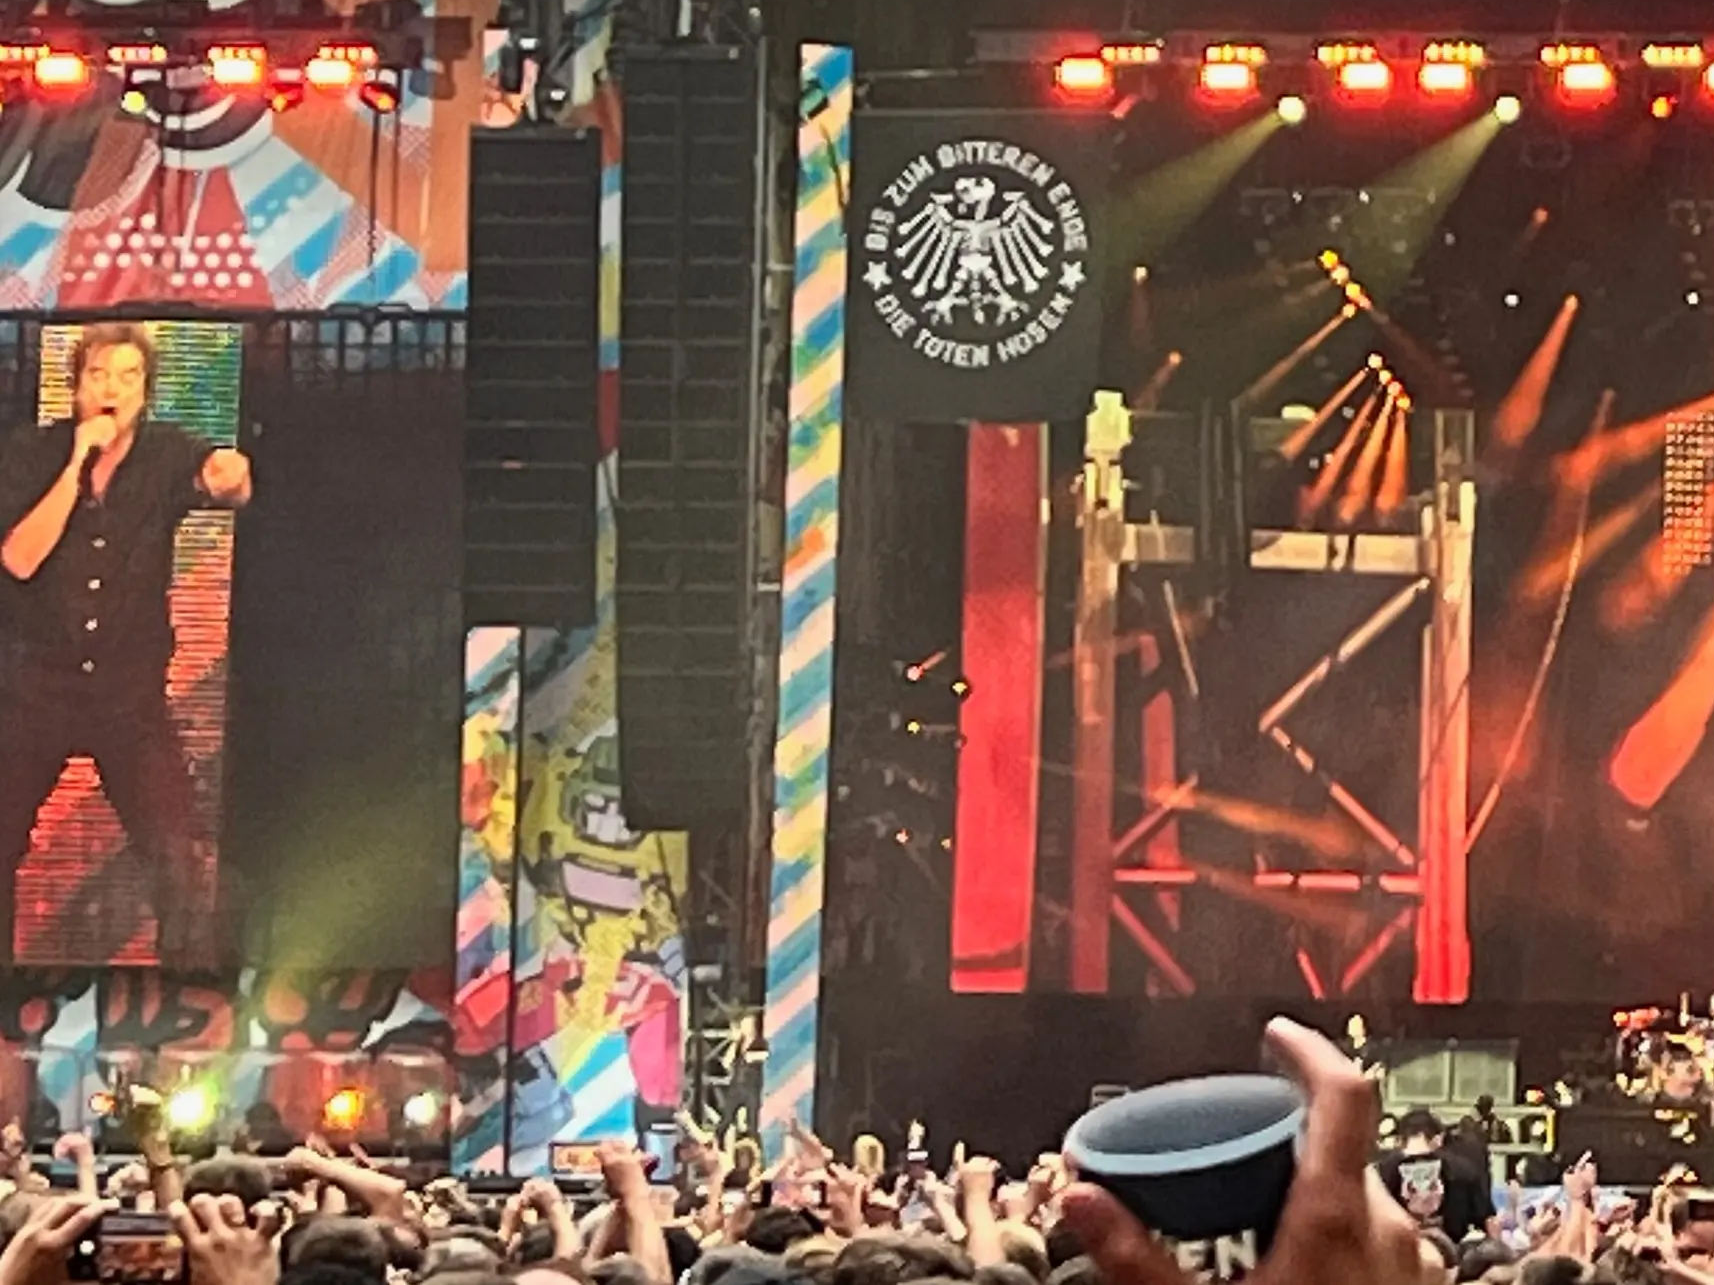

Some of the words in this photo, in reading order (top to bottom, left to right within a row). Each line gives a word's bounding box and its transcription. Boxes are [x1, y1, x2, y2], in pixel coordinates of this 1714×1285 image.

[882, 154, 935, 207] ZUM
[1046, 180, 1089, 253] ENDE
[874, 293, 918, 339] DIE
[912, 327, 991, 367] TOTEN
